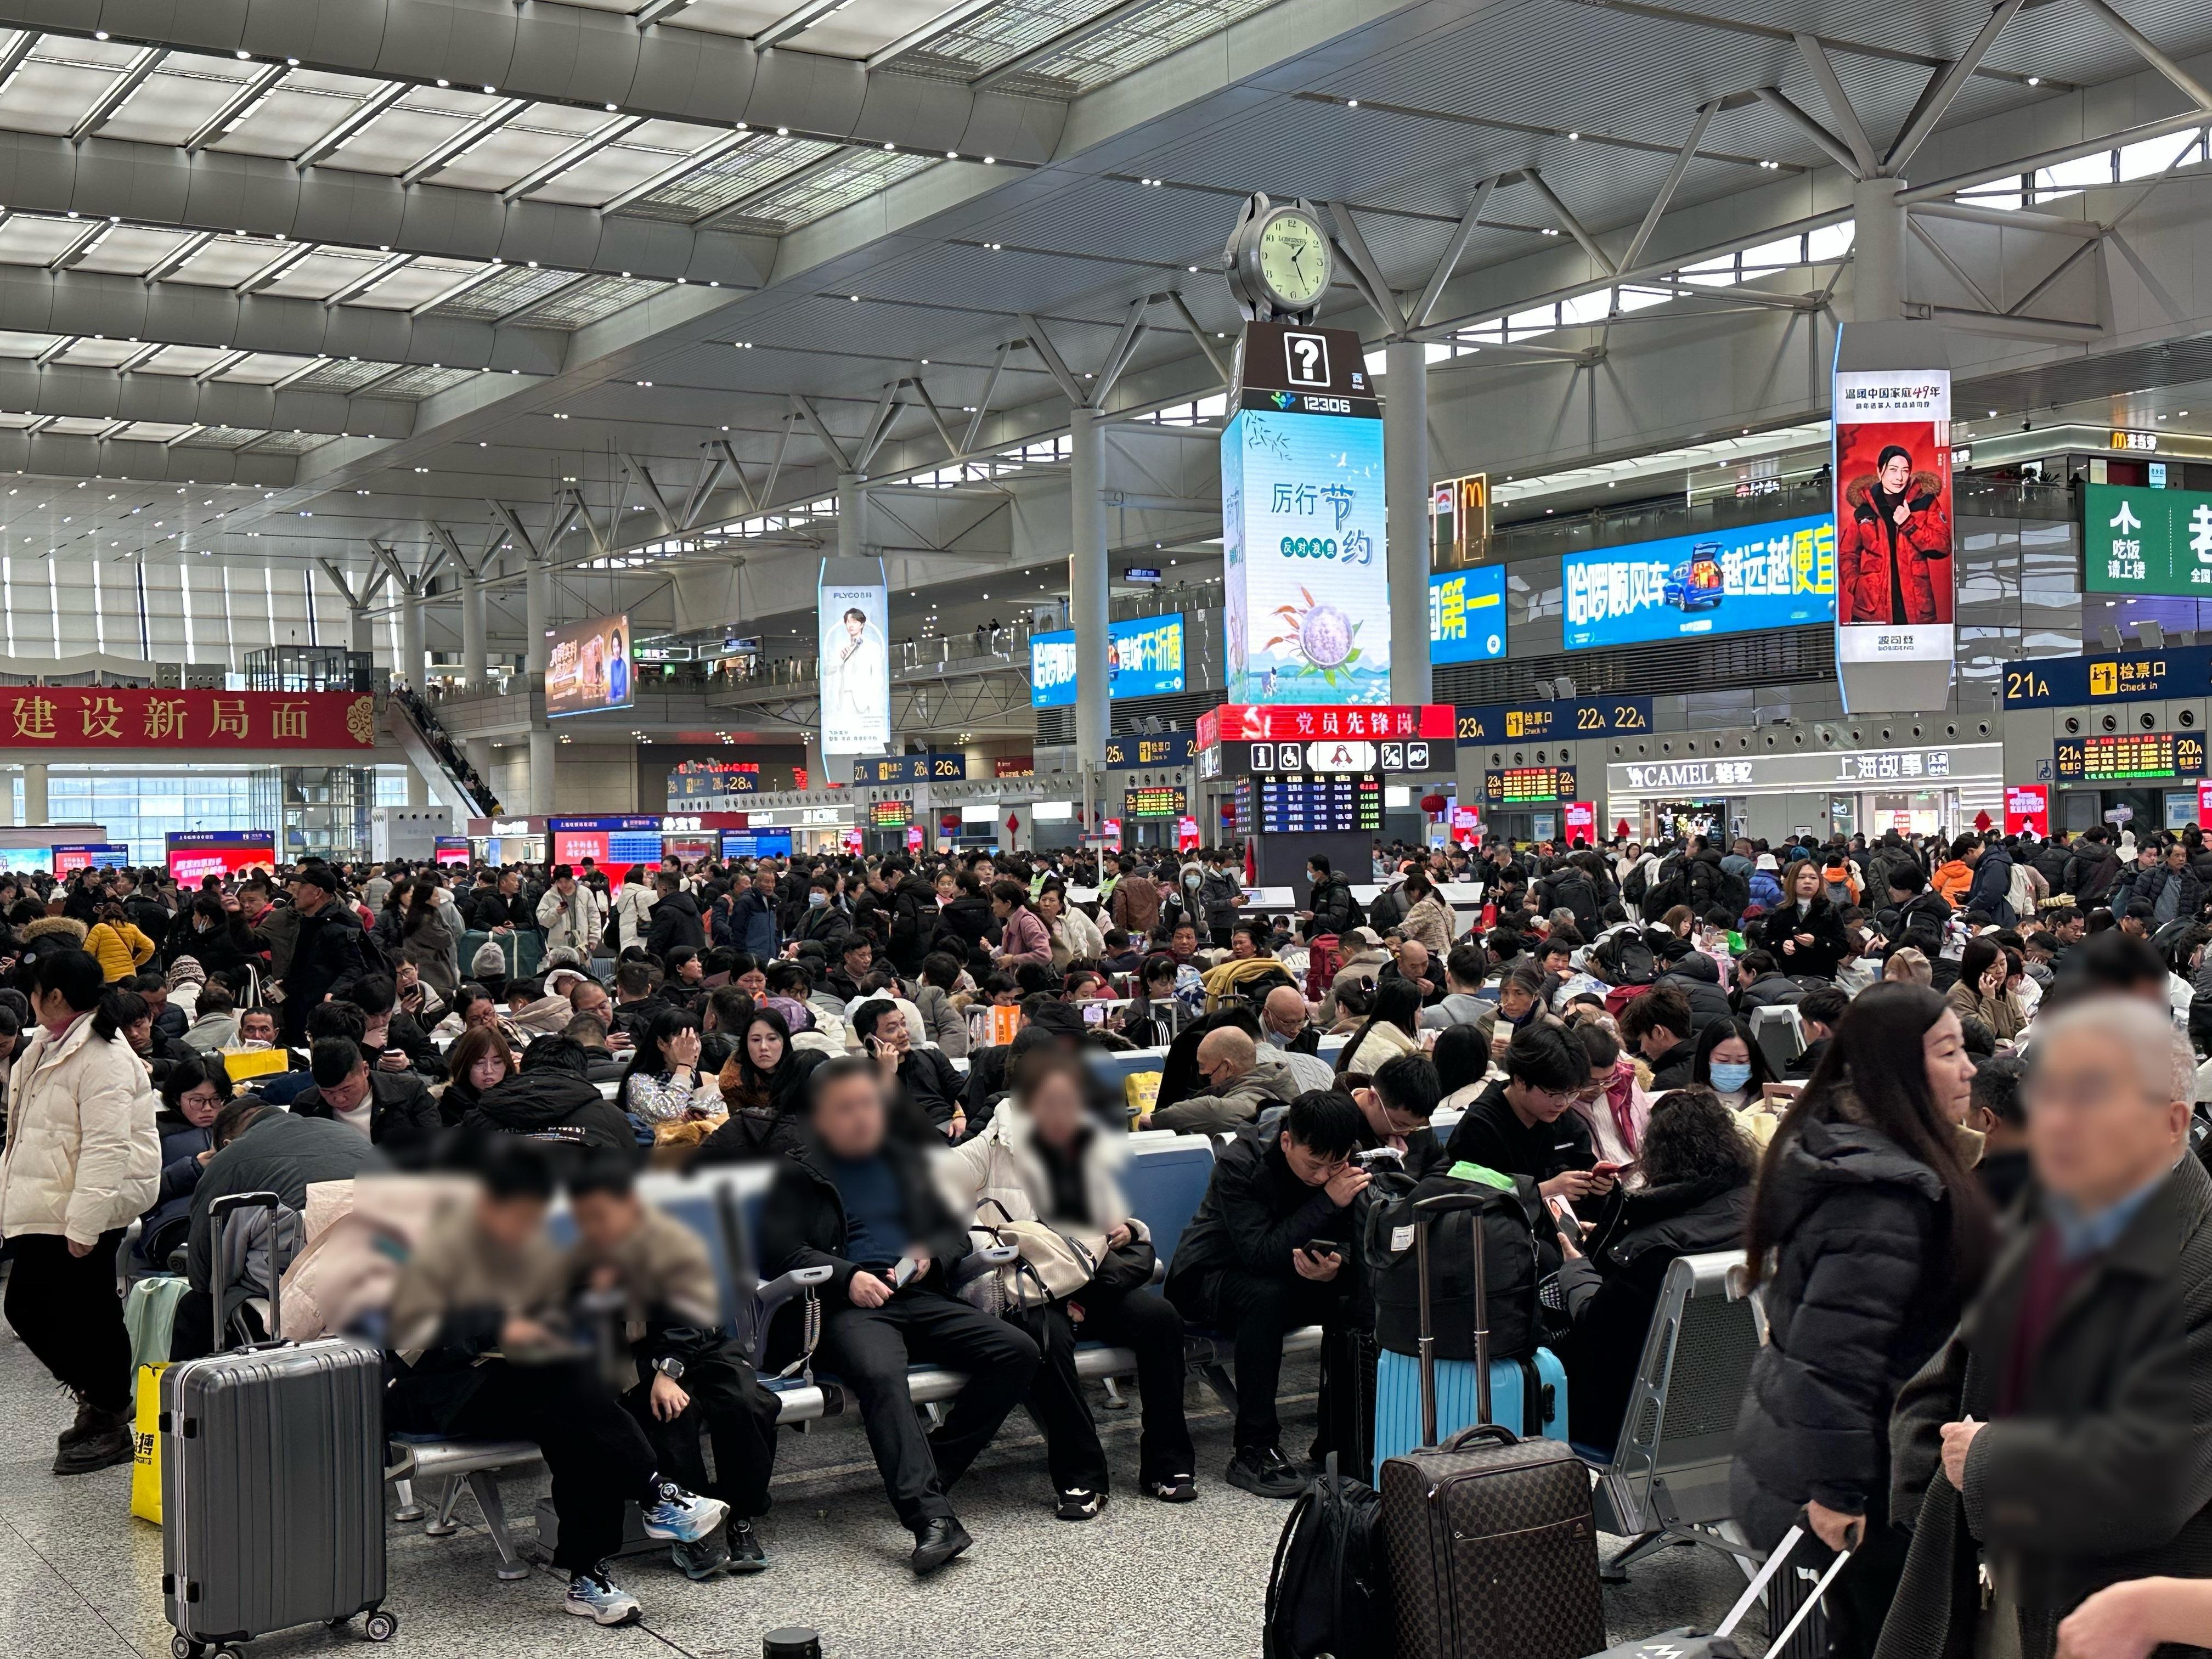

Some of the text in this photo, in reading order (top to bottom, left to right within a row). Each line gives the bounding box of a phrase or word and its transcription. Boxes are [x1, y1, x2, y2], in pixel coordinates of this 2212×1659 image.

[1276, 222, 1281, 231] 11
[1288, 219, 1296, 228] 12
[1317, 258, 1323, 267] 3
[1266, 270, 1272, 278] 8
[1290, 291, 1296, 299] 6
[1304, 396, 1351, 413] 12306
[2113, 539, 2140, 560] 吃饭
[1721, 521, 1834, 596] 越远越便宜
[2108, 560, 2146, 579] 请上楼
[2191, 568, 2212, 584] 全国
[2120, 661, 2166, 680] 检票口
[2007, 671, 2050, 699] 21A
[2120, 682, 2158, 692] Check in
[11, 695, 309, 740] 建设新局面
[1296, 712, 1412, 735] 党员先锋岗
[1577, 708, 1606, 730] 22A
[1615, 706, 1646, 728] 22A
[1458, 718, 1485, 738] 23A
[1107, 746, 1125, 763] 25A
[2058, 746, 2081, 760] 21A
[2177, 740, 2203, 755] 20A
[855, 765, 868, 781] 27A
[935, 760, 961, 776] 26A
[1836, 753, 1922, 781] 上海故事
[729, 776, 753, 790] 28A
[1487, 775, 1502, 787] 23A
[1559, 771, 1575, 784] 22A
[1644, 764, 1714, 787] CAMEL
